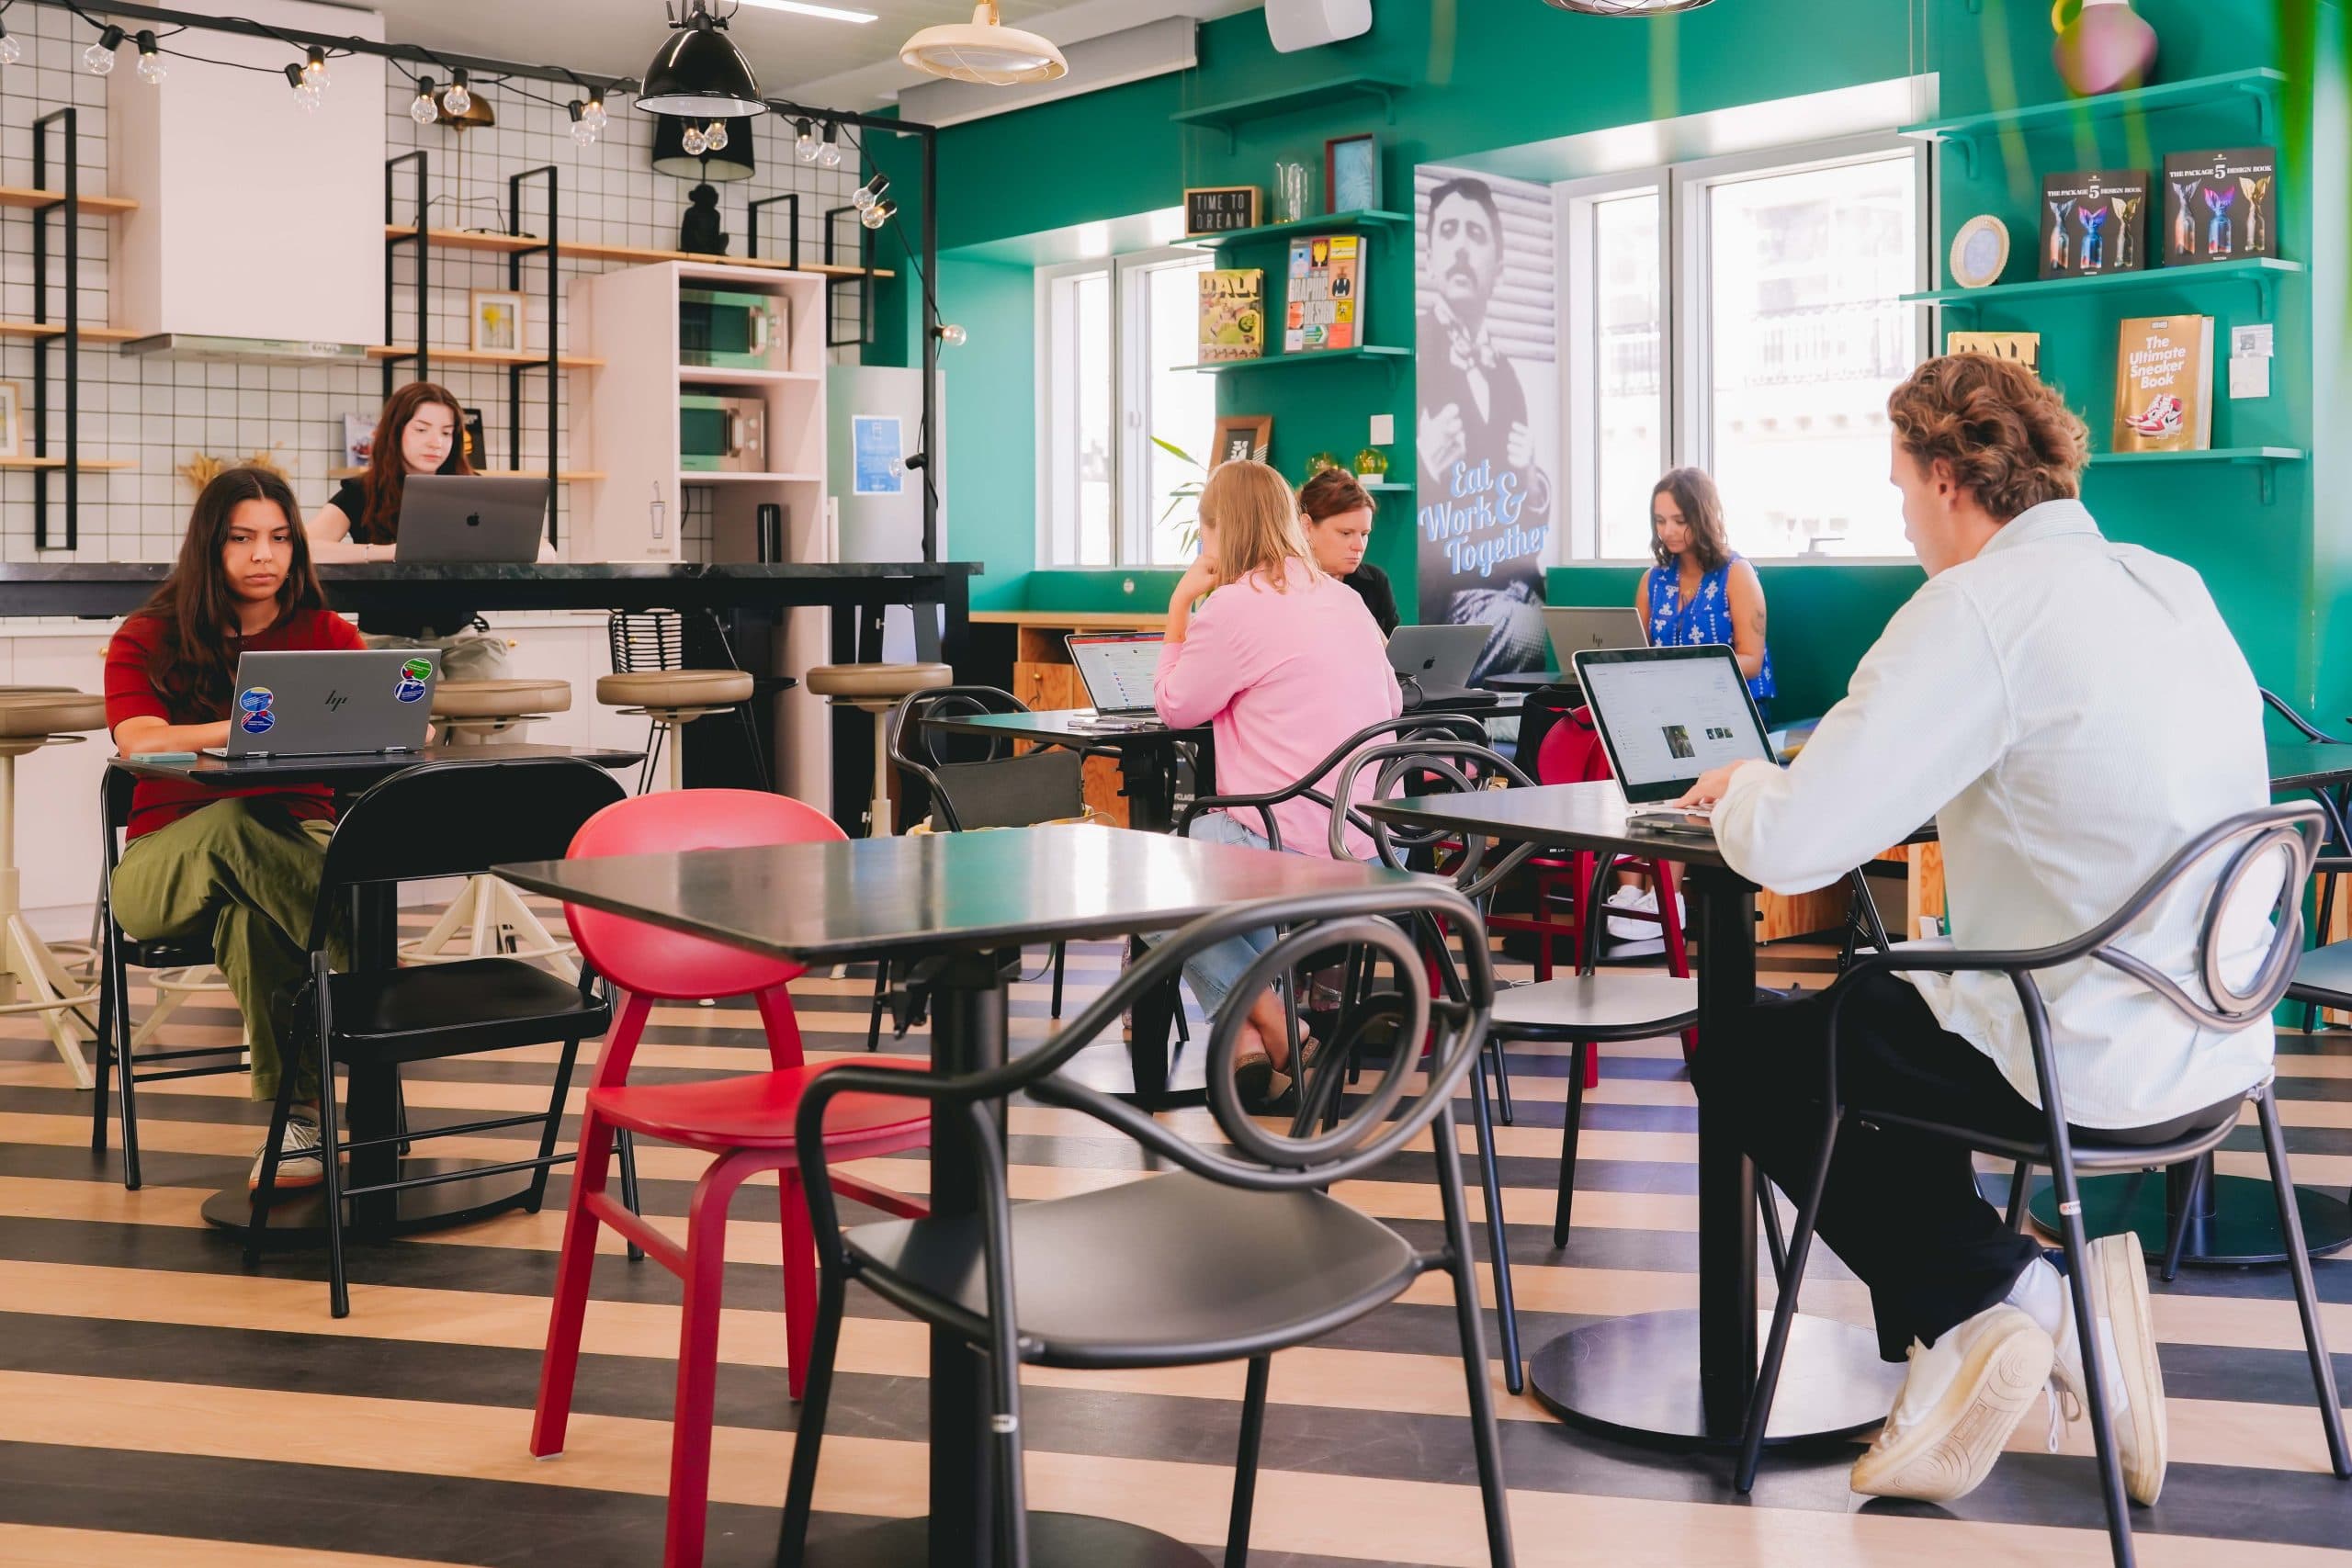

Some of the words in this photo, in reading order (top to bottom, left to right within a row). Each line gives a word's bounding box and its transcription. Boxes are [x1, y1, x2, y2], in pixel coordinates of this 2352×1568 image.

[2184, 168, 2214, 177] PACKAGE
[2214, 164, 2226, 179] 5
[2226, 165, 2252, 175] DESIGN
[2253, 164, 2272, 173] BOOK
[2088, 185, 2100, 199] 5
[1196, 194, 1223, 211] TIME
[1231, 193, 1245, 209] TO
[1196, 212, 1245, 230] DREAM
[2146, 335, 2169, 349] The
[2129, 346, 2187, 365] Ultimate
[2130, 359, 2185, 378] Sneaker
[2140, 375, 2175, 389] Book
[1450, 457, 1494, 499] Eat
[1419, 495, 1498, 543] Work
[1495, 470, 1528, 525] &
[1443, 524, 1549, 578] Together
[324, 690, 348, 712] hp
